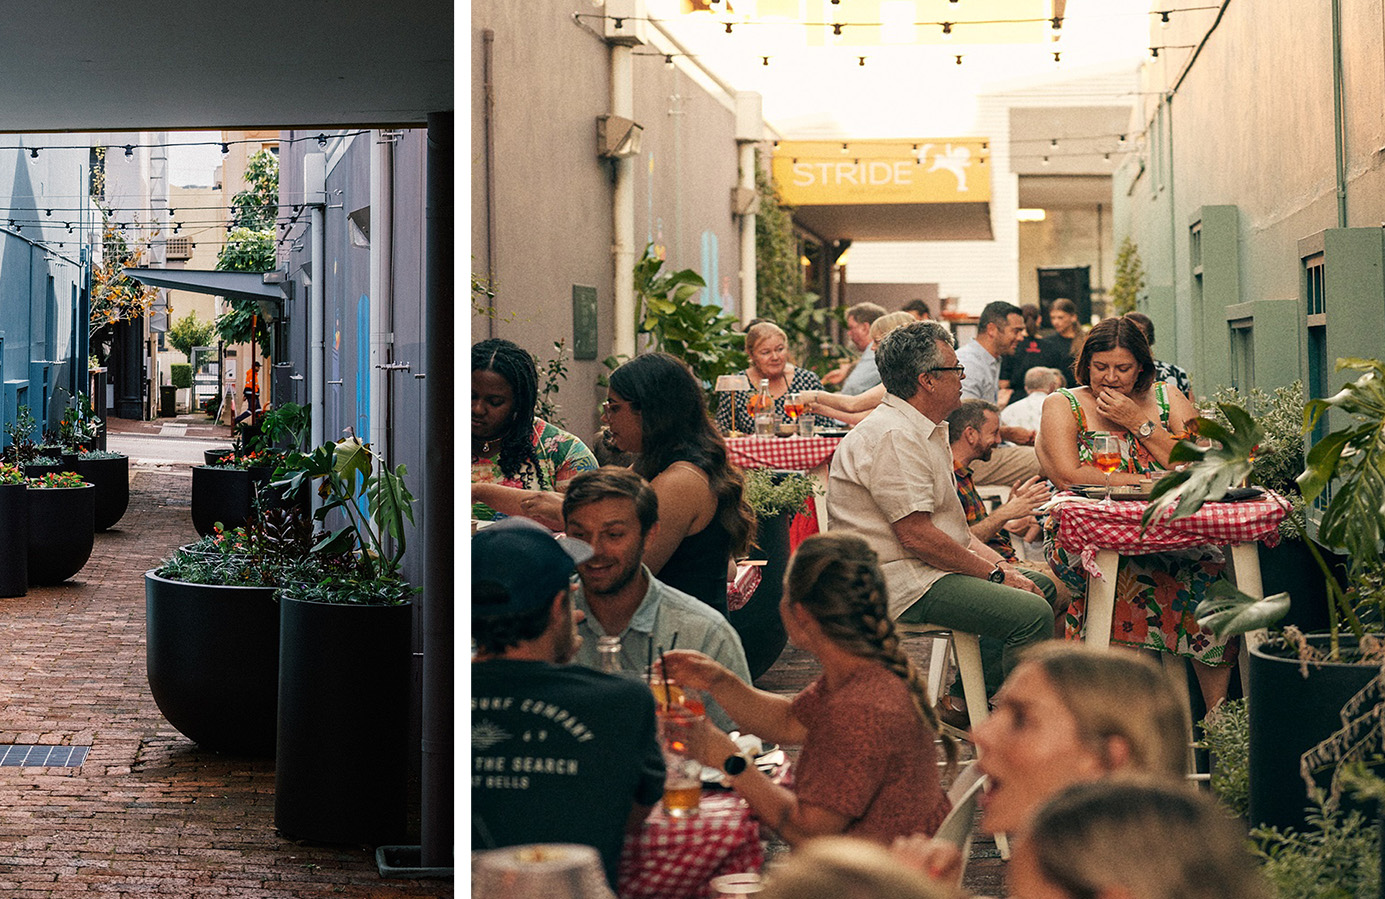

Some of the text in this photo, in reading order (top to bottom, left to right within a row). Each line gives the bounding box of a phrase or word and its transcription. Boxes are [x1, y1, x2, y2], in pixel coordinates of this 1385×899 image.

[793, 161, 912, 187] STRIDE
[520, 698, 594, 742] COMPANY
[475, 757, 578, 775] THE SEARCH
